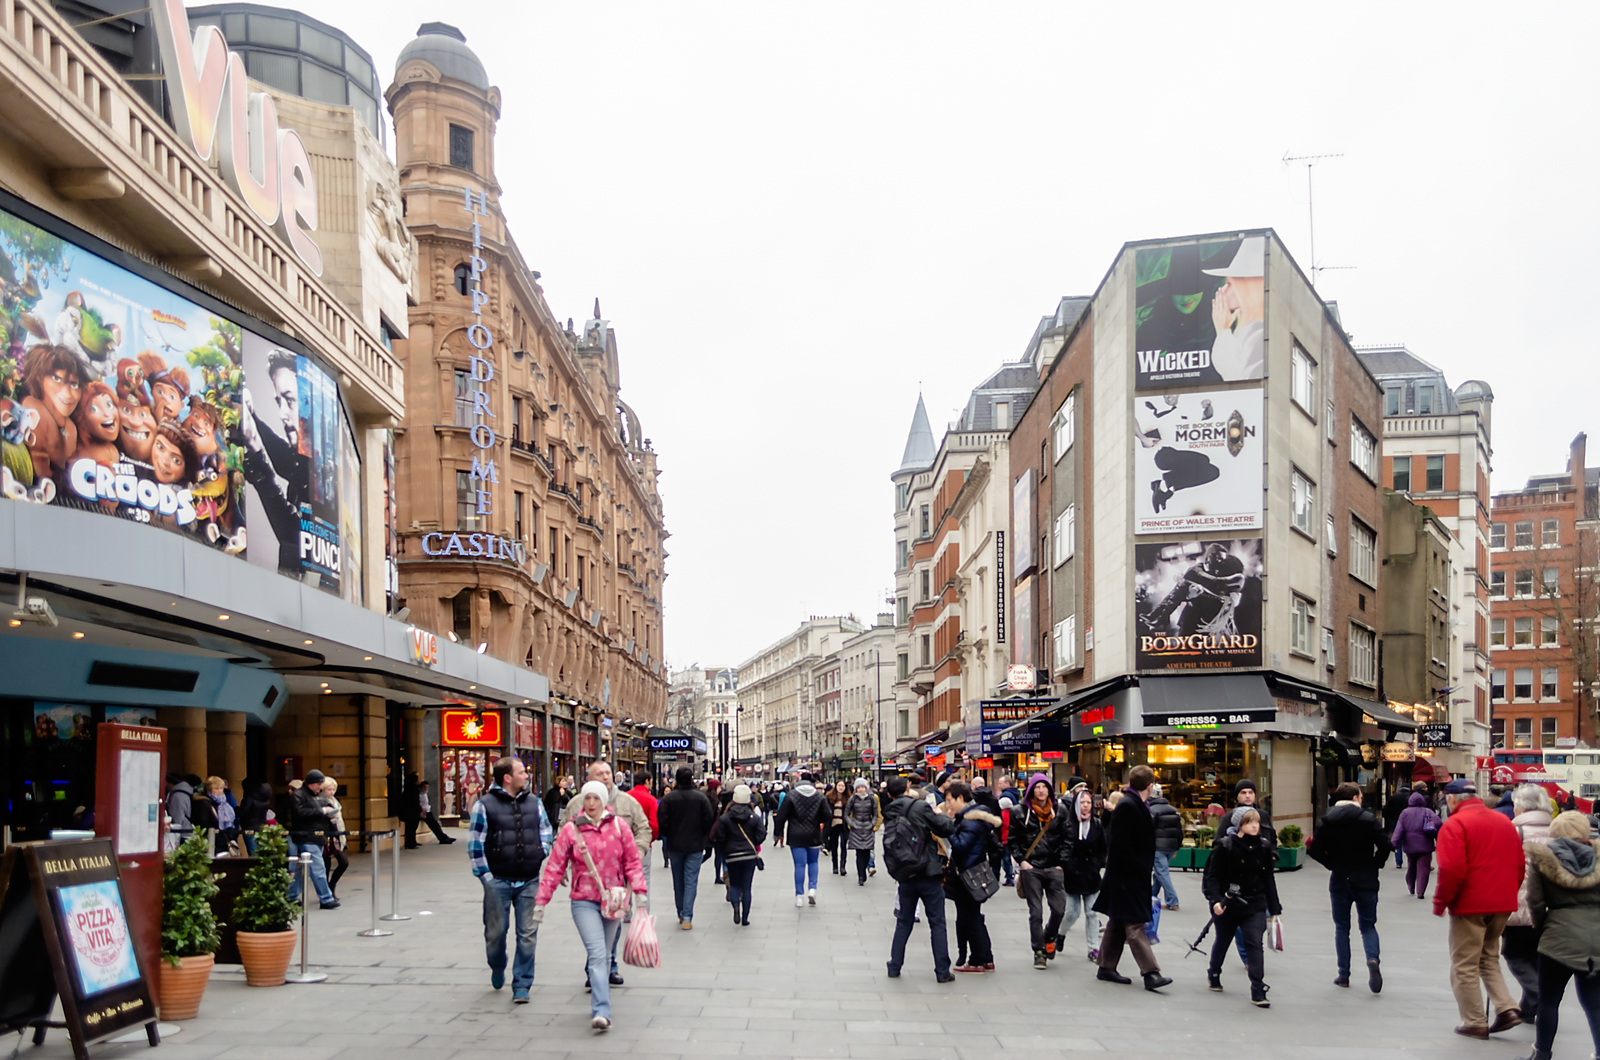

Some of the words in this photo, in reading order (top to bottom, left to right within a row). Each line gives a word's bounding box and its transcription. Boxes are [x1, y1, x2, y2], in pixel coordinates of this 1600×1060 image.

[80, 277, 99, 291] FROM
[99, 286, 112, 297] THE
[112, 293, 142, 311] CREATORS
[463, 186, 499, 515] HIPPODROME
[112, 463, 136, 476] THE
[70, 458, 197, 526] CROODS
[135, 508, 151, 522] 3D
[1141, 520, 1171, 528] PRINCE
[1185, 517, 1215, 525] WALES
[1216, 515, 1255, 524] THEATRE
[300, 518, 329, 540] WELCOME
[421, 531, 526, 566] CASINO
[1140, 634, 1258, 652] BODYGUARD
[982, 708, 996, 720] WE
[996, 707, 1016, 719] WILL
[1167, 715, 1217, 725] ESPRESSO
[1229, 714, 1250, 723] BAR
[121, 729, 141, 740] BELLA
[141, 731, 162, 742] ITALIA
[650, 738, 689, 748] CASINO
[44, 859, 78, 874] BELLA
[79, 855, 111, 870] ITALIA
[76, 908, 115, 930] PIZZA
[86, 928, 114, 949] VITA
